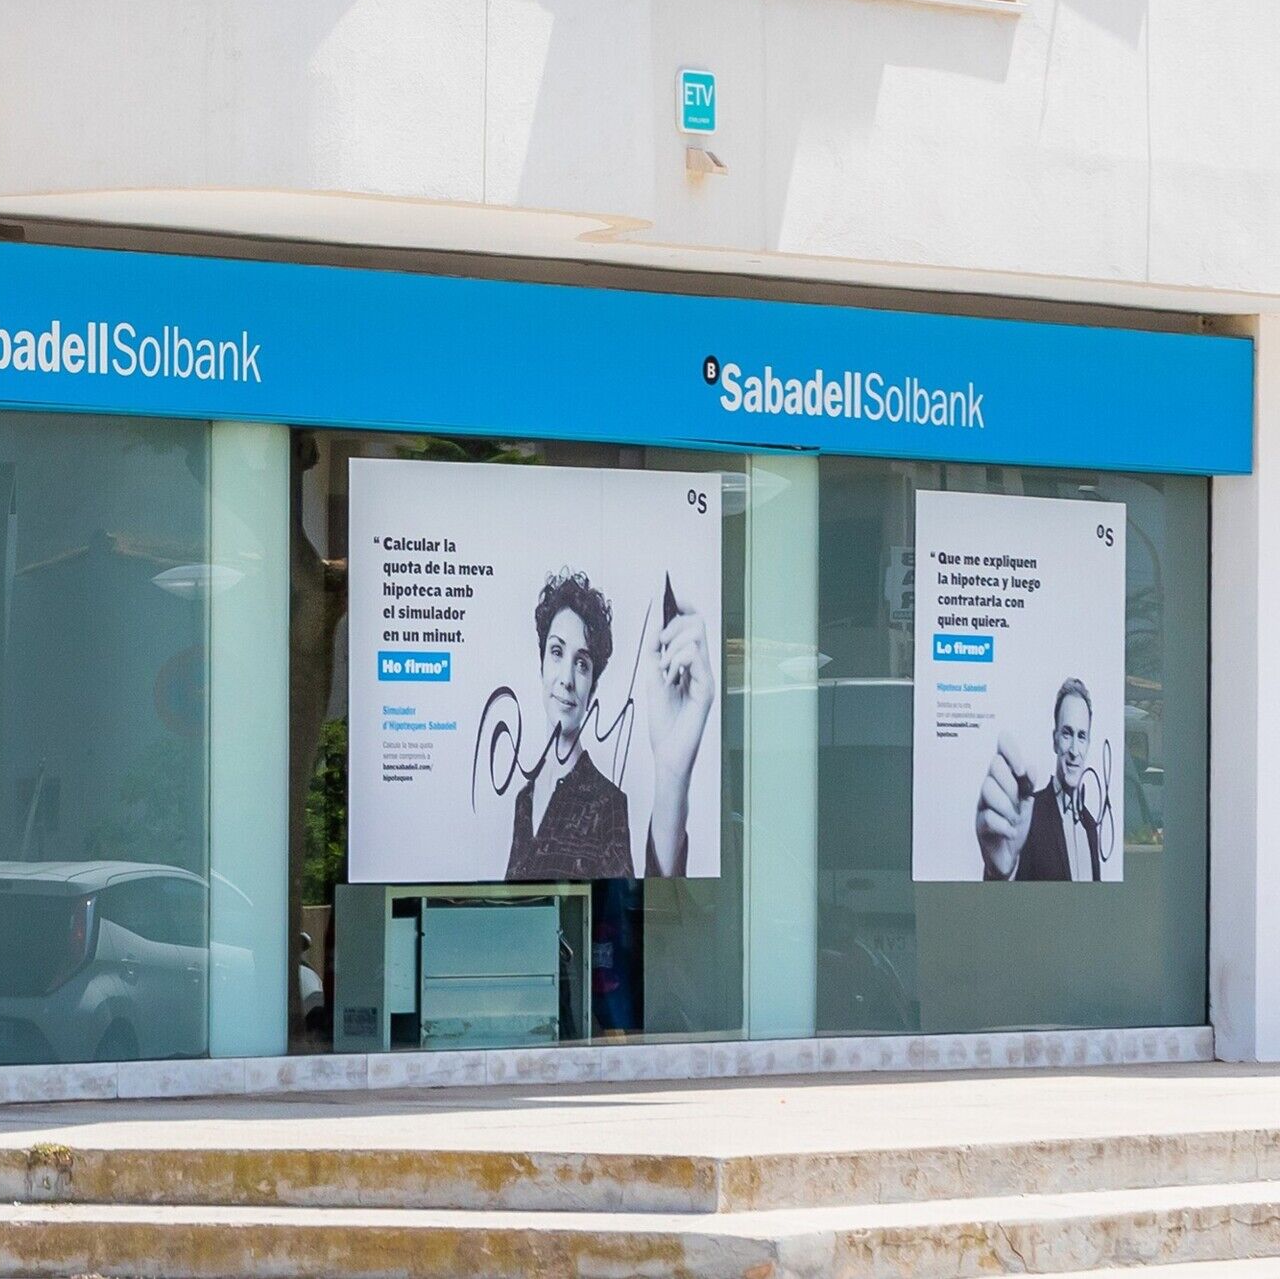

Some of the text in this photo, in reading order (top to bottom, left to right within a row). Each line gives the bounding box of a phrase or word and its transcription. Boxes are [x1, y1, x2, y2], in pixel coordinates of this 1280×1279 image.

[684, 82, 714, 107] ETV
[444, 538, 456, 553] la
[383, 560, 494, 577] quota de la meva
[963, 554, 981, 566] me
[983, 554, 1037, 570] expliquen
[937, 572, 1041, 592] la hipoteca y luego
[383, 582, 474, 600] hipoteca amb
[937, 594, 1025, 608] contratarla con
[383, 605, 466, 620] el simulador
[937, 614, 1010, 631] quien quiera.
[383, 628, 465, 643] en un minut.
[936, 641, 952, 654] Lo
[382, 659, 402, 673] Ho
[428, 721, 457, 730] Sabadell
